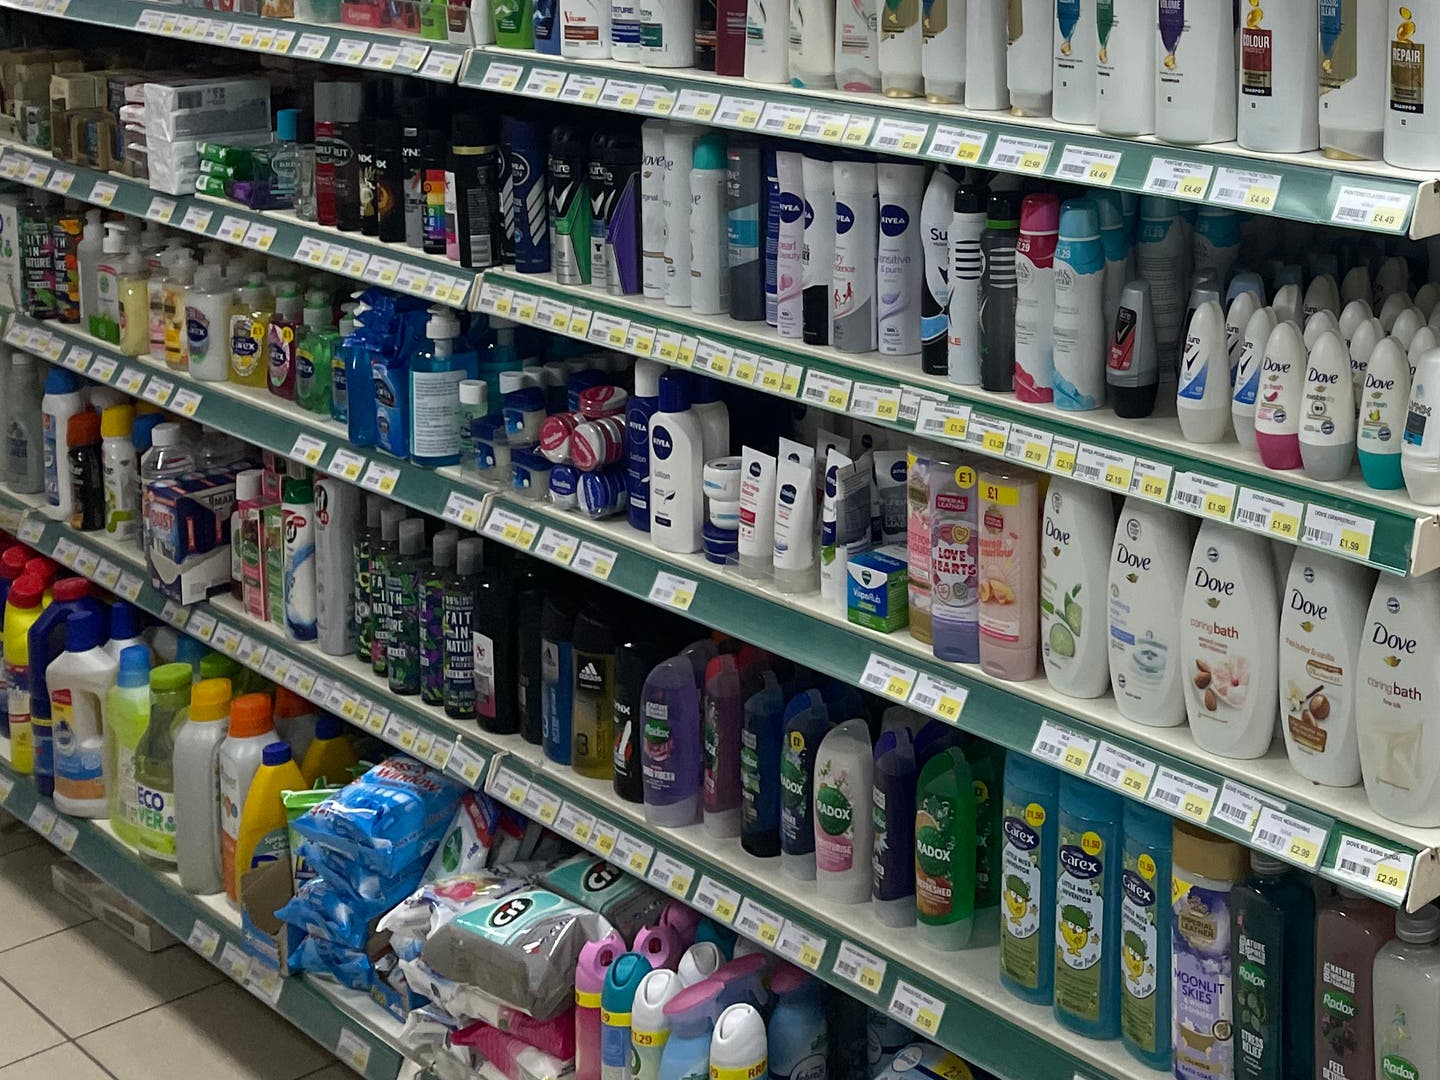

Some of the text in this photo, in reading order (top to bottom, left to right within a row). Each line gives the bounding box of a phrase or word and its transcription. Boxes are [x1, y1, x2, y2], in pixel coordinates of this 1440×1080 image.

[1160, 0, 1181, 9] VOLUME
[1243, 34, 1270, 48] COLOUR
[1392, 48, 1421, 63] REPAIR
[1024, 159, 1041, 169] £2.99
[1183, 184, 1202, 195] £4.49
[1250, 194, 1270, 205] £4.49
[1373, 213, 1395, 224] £4.49
[931, 228, 948, 241] Su
[1263, 357, 1291, 373] Dove
[1308, 368, 1339, 384] Dove
[1365, 374, 1395, 390] Dove
[629, 421, 647, 432] NIVEA
[652, 437, 671, 449] NIVEA
[1025, 448, 1042, 461] £2.19
[1056, 458, 1073, 470] £2.19
[654, 469, 671, 480] Lotion
[959, 472, 973, 483] £1
[1105, 472, 1122, 485] £2.19
[987, 486, 998, 500] £1
[1144, 483, 1161, 496] £1.99
[1208, 501, 1226, 514] £1.99
[1045, 517, 1070, 545] Dove
[1272, 519, 1291, 533] £1.99
[1339, 537, 1360, 552] £1.99
[938, 548, 966, 562] LOVE
[1117, 542, 1151, 572] Dove
[932, 562, 977, 576] HEARTS
[1195, 567, 1235, 596] Dove
[852, 587, 881, 604] VapoRub
[1290, 589, 1328, 620] Dove
[1372, 622, 1417, 654] Dove
[1065, 752, 1083, 767] £2.99
[1123, 775, 1142, 790] £2.99
[137, 786, 164, 811] ECO
[817, 799, 850, 820] RADOX
[1026, 810, 1044, 819] £1.50
[1184, 802, 1203, 816] £2.99
[1004, 820, 1034, 845] Carex
[1082, 837, 1100, 849] £1.50
[917, 840, 951, 862] RADOX
[1290, 844, 1310, 859] £2.99
[1006, 859, 1030, 875] INVENTOR
[1018, 855, 1031, 867] MISS
[1060, 850, 1097, 872] Carex
[1139, 860, 1154, 873] £1.50
[1122, 874, 1151, 900] Carex
[1376, 872, 1398, 887] £2.99
[1061, 879, 1093, 896] LITTLE MISS
[1062, 888, 1092, 904] INVENTOR
[494, 899, 531, 927] Cif
[1135, 912, 1148, 925] MISS
[1181, 923, 1214, 938] LEATHER
[1239, 966, 1266, 988] Radox
[1330, 964, 1356, 980] NATURE
[1174, 970, 1225, 994] MOONLIT
[1182, 987, 1212, 1005] SKIES
[1323, 993, 1355, 1017] Radox
[1241, 1029, 1264, 1049] STRESS
[1241, 1041, 1263, 1060] RELIEF
[747, 1062, 767, 1077] RRP
[1383, 1057, 1417, 1080] Radox
